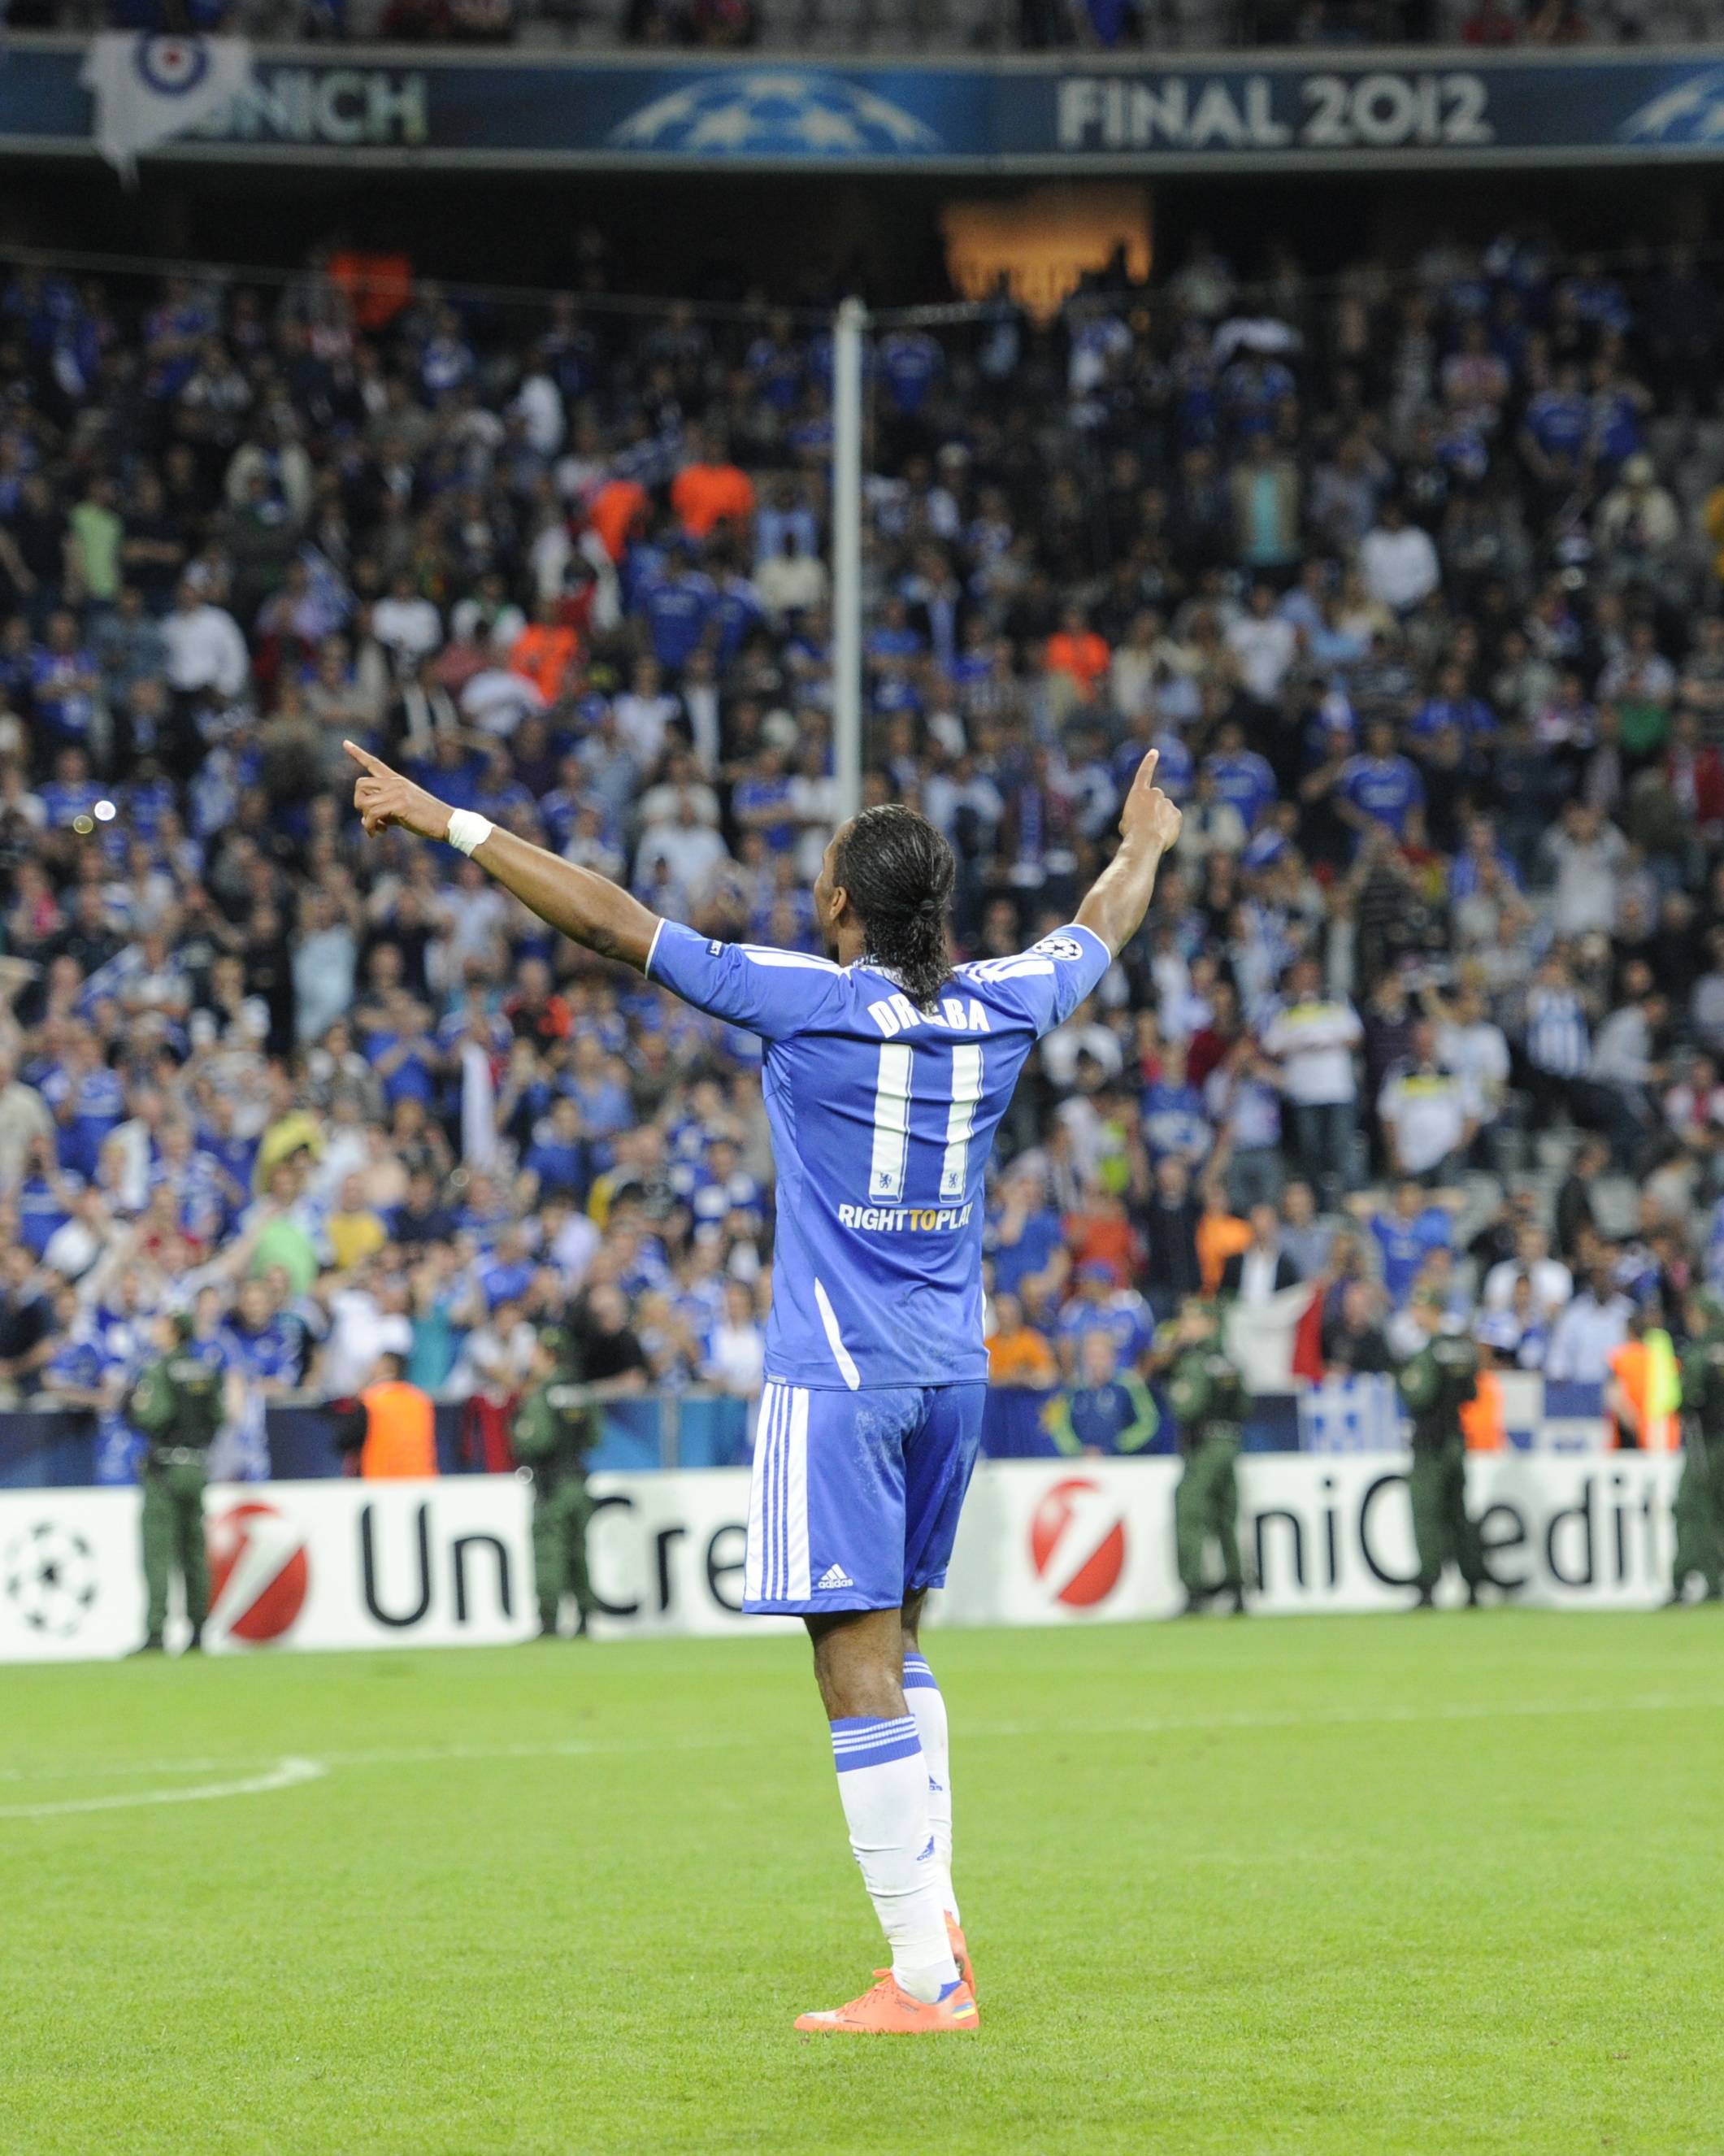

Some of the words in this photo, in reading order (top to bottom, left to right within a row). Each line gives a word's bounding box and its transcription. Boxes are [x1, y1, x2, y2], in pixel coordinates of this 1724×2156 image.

[199, 70, 429, 141] NICH
[1057, 75, 1292, 147] FINAL
[1301, 73, 1494, 145] 2012
[869, 1043, 984, 1203] 11
